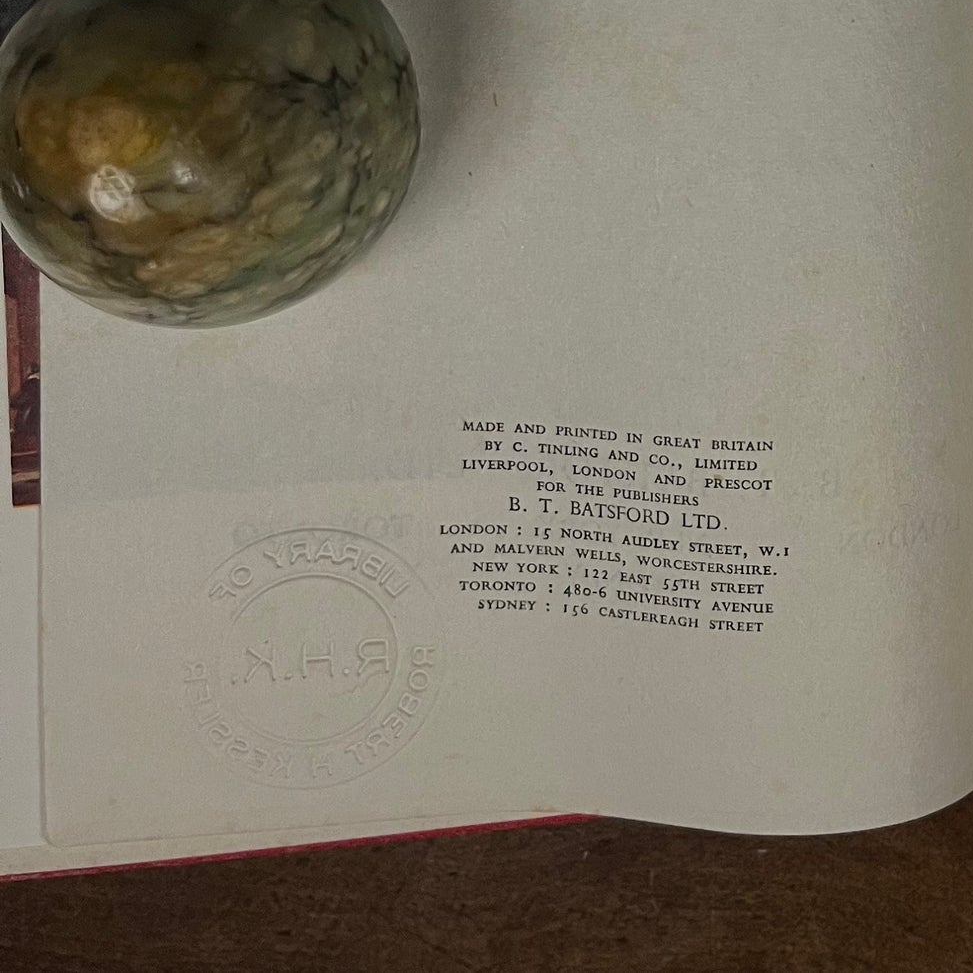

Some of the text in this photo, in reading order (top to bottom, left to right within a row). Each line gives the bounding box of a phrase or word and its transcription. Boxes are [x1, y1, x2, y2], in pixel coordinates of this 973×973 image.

[463, 421, 773, 451] MADE AND PRINTED IN GREAT BRITAIN
[485, 441, 757, 471] BY C. TINLING AND CO., LIMITED
[462, 460, 772, 490] LIVERPOOL, LONDON AND PRESCOT
[537, 481, 698, 506] FOR THE PUBLISHERS
[509, 497, 727, 530] B. T. BATSFORD LTD.
[440, 525, 507, 535] LONDON
[534, 527, 551, 540] 15
[561, 528, 612, 543] NORTH
[622, 535, 679, 550] AUDLEY
[689, 542, 747, 559] STREET,
[451, 543, 777, 575] AND MALVERN WELLS, WORCESTERSHIRE.
[473, 562, 508, 572] NEW
[517, 563, 559, 574] YORK
[585, 569, 608, 579] 122
[620, 572, 652, 585] EAST
[663, 579, 699, 591] 55TH
[711, 582, 764, 594] STREET
[459, 581, 536, 592] TORONTO
[564, 584, 606, 598] 480-6
[616, 590, 701, 609] UNIVERSITY
[712, 601, 773, 613] AVENUE
[478, 600, 536, 610] SYDNEY
[564, 604, 588, 616] 156
[599, 607, 698, 628] CASTLEREAGH
[710, 620, 763, 632] STREET
